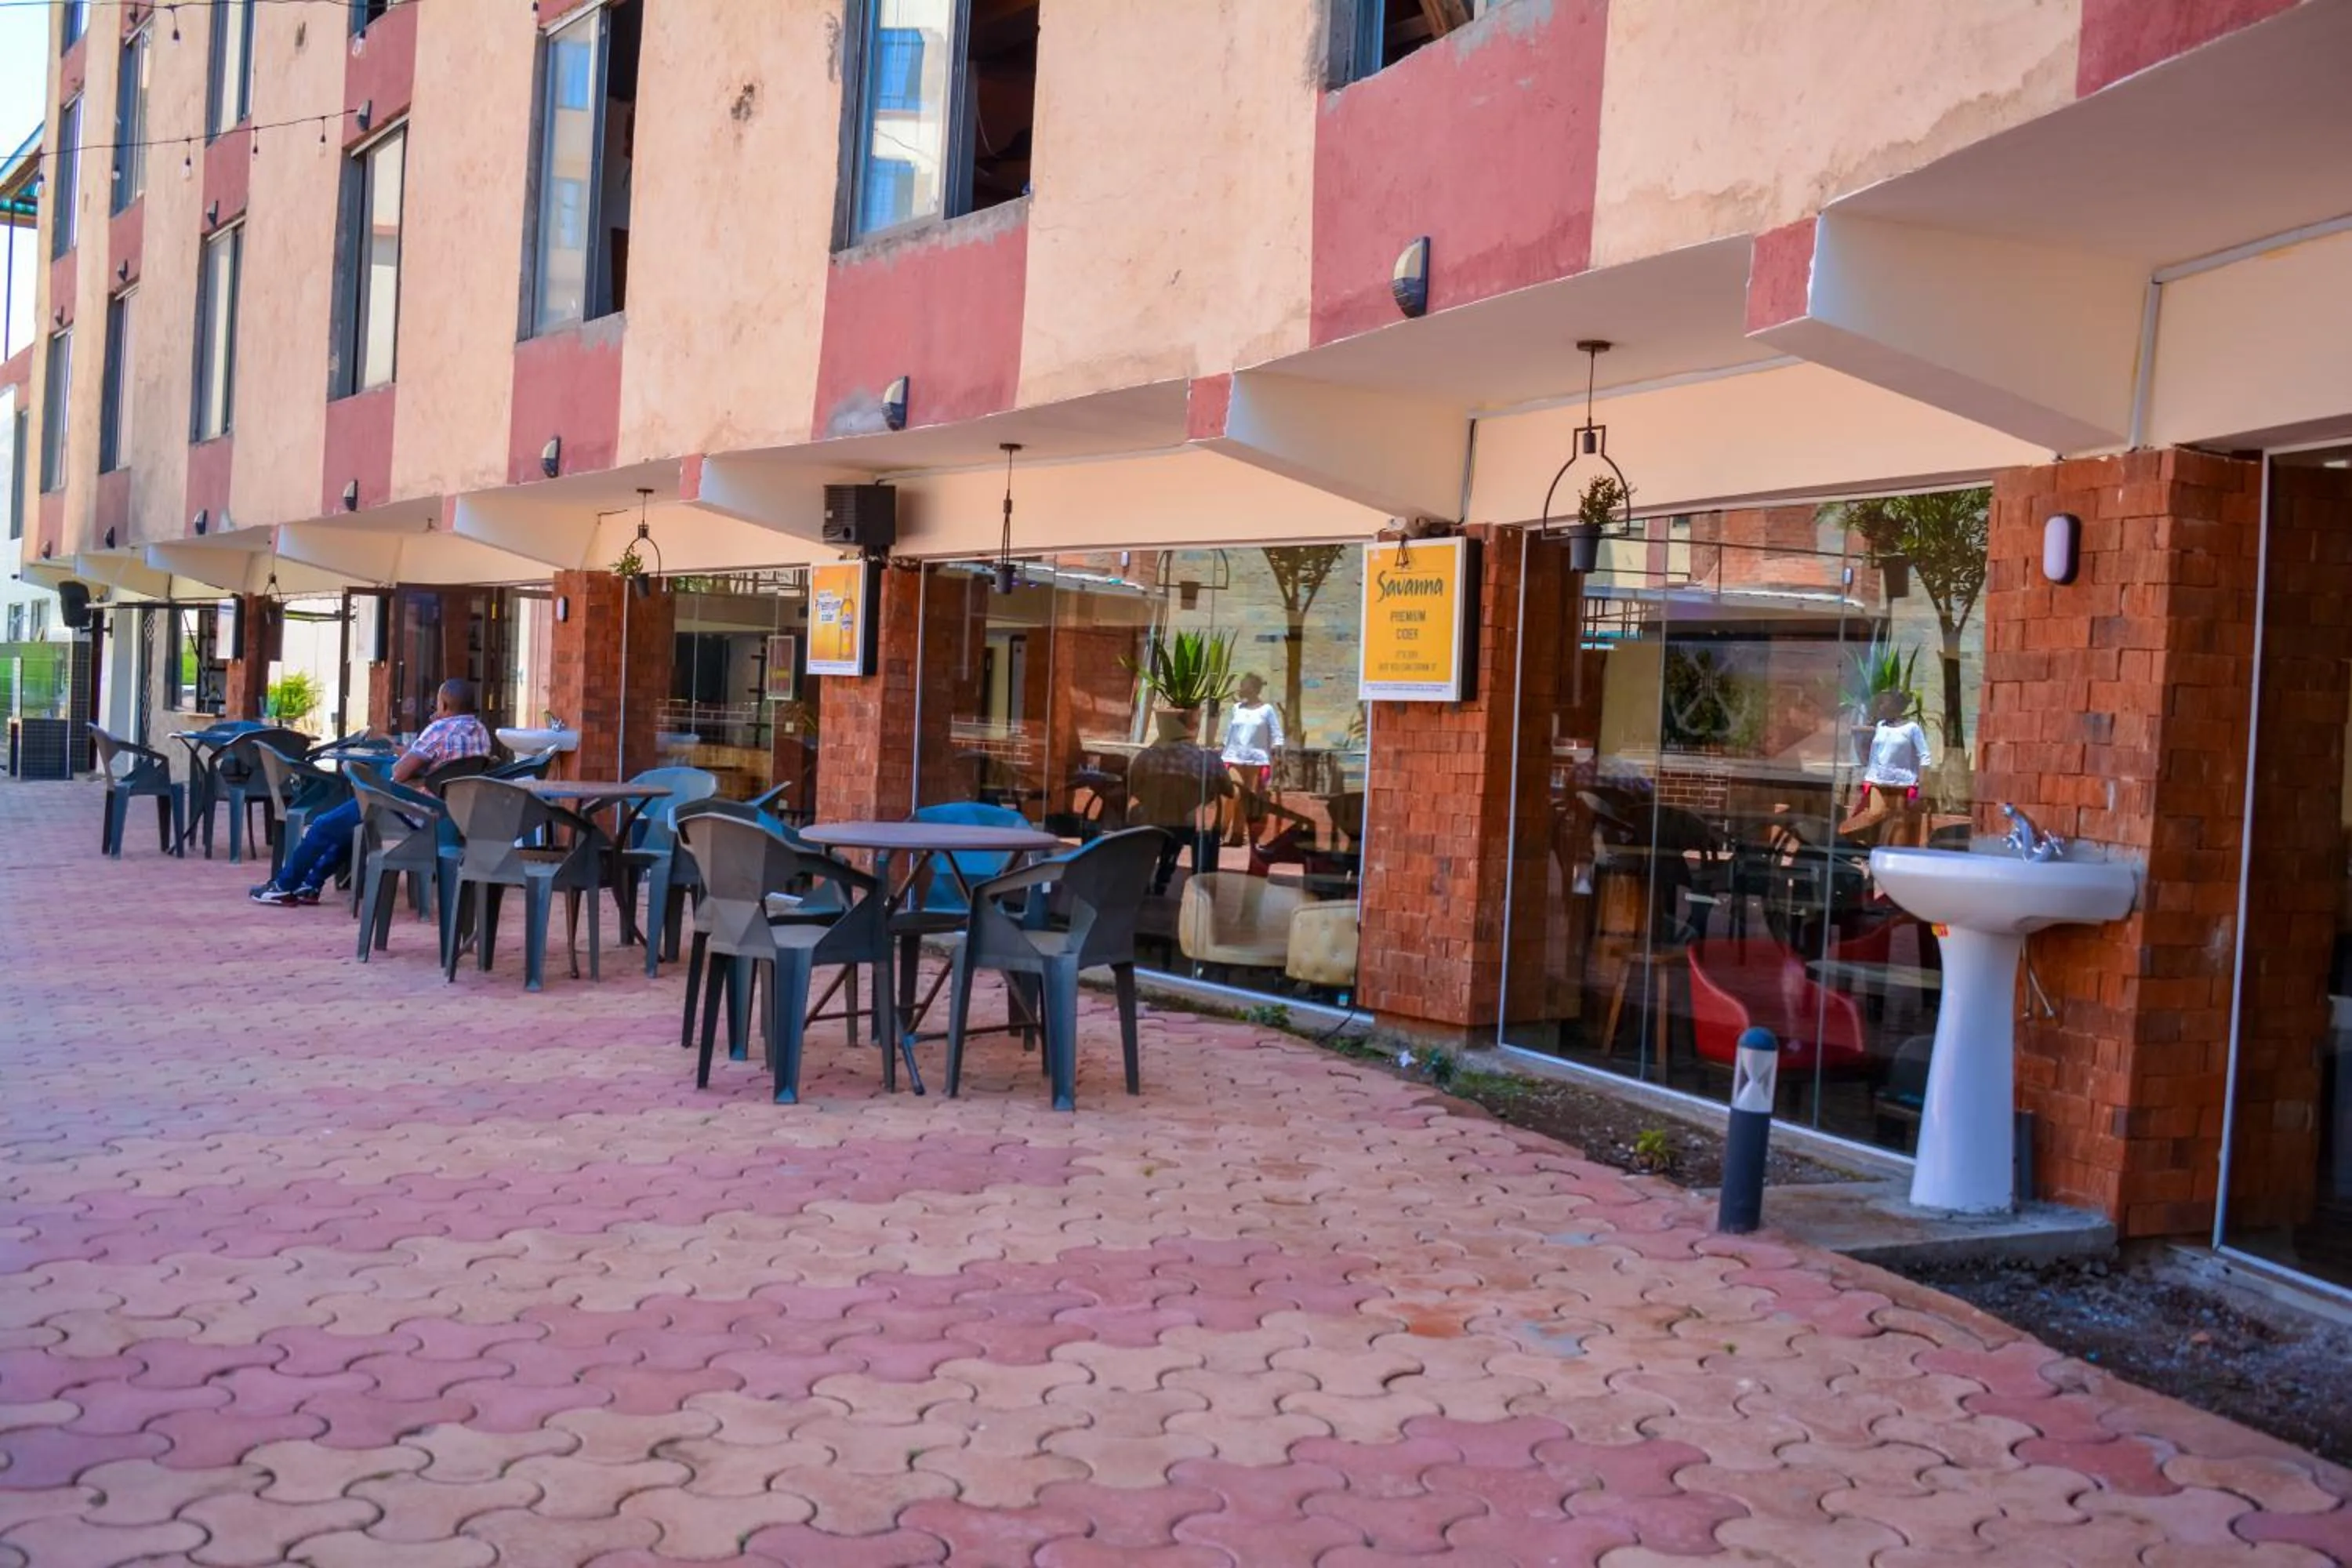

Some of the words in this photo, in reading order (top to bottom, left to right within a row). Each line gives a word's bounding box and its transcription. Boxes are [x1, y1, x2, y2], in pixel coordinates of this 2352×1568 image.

[1377, 570, 1443, 602] Savanna
[1390, 609, 1426, 622] PREMIUM
[1396, 628, 1418, 640] CIDER
